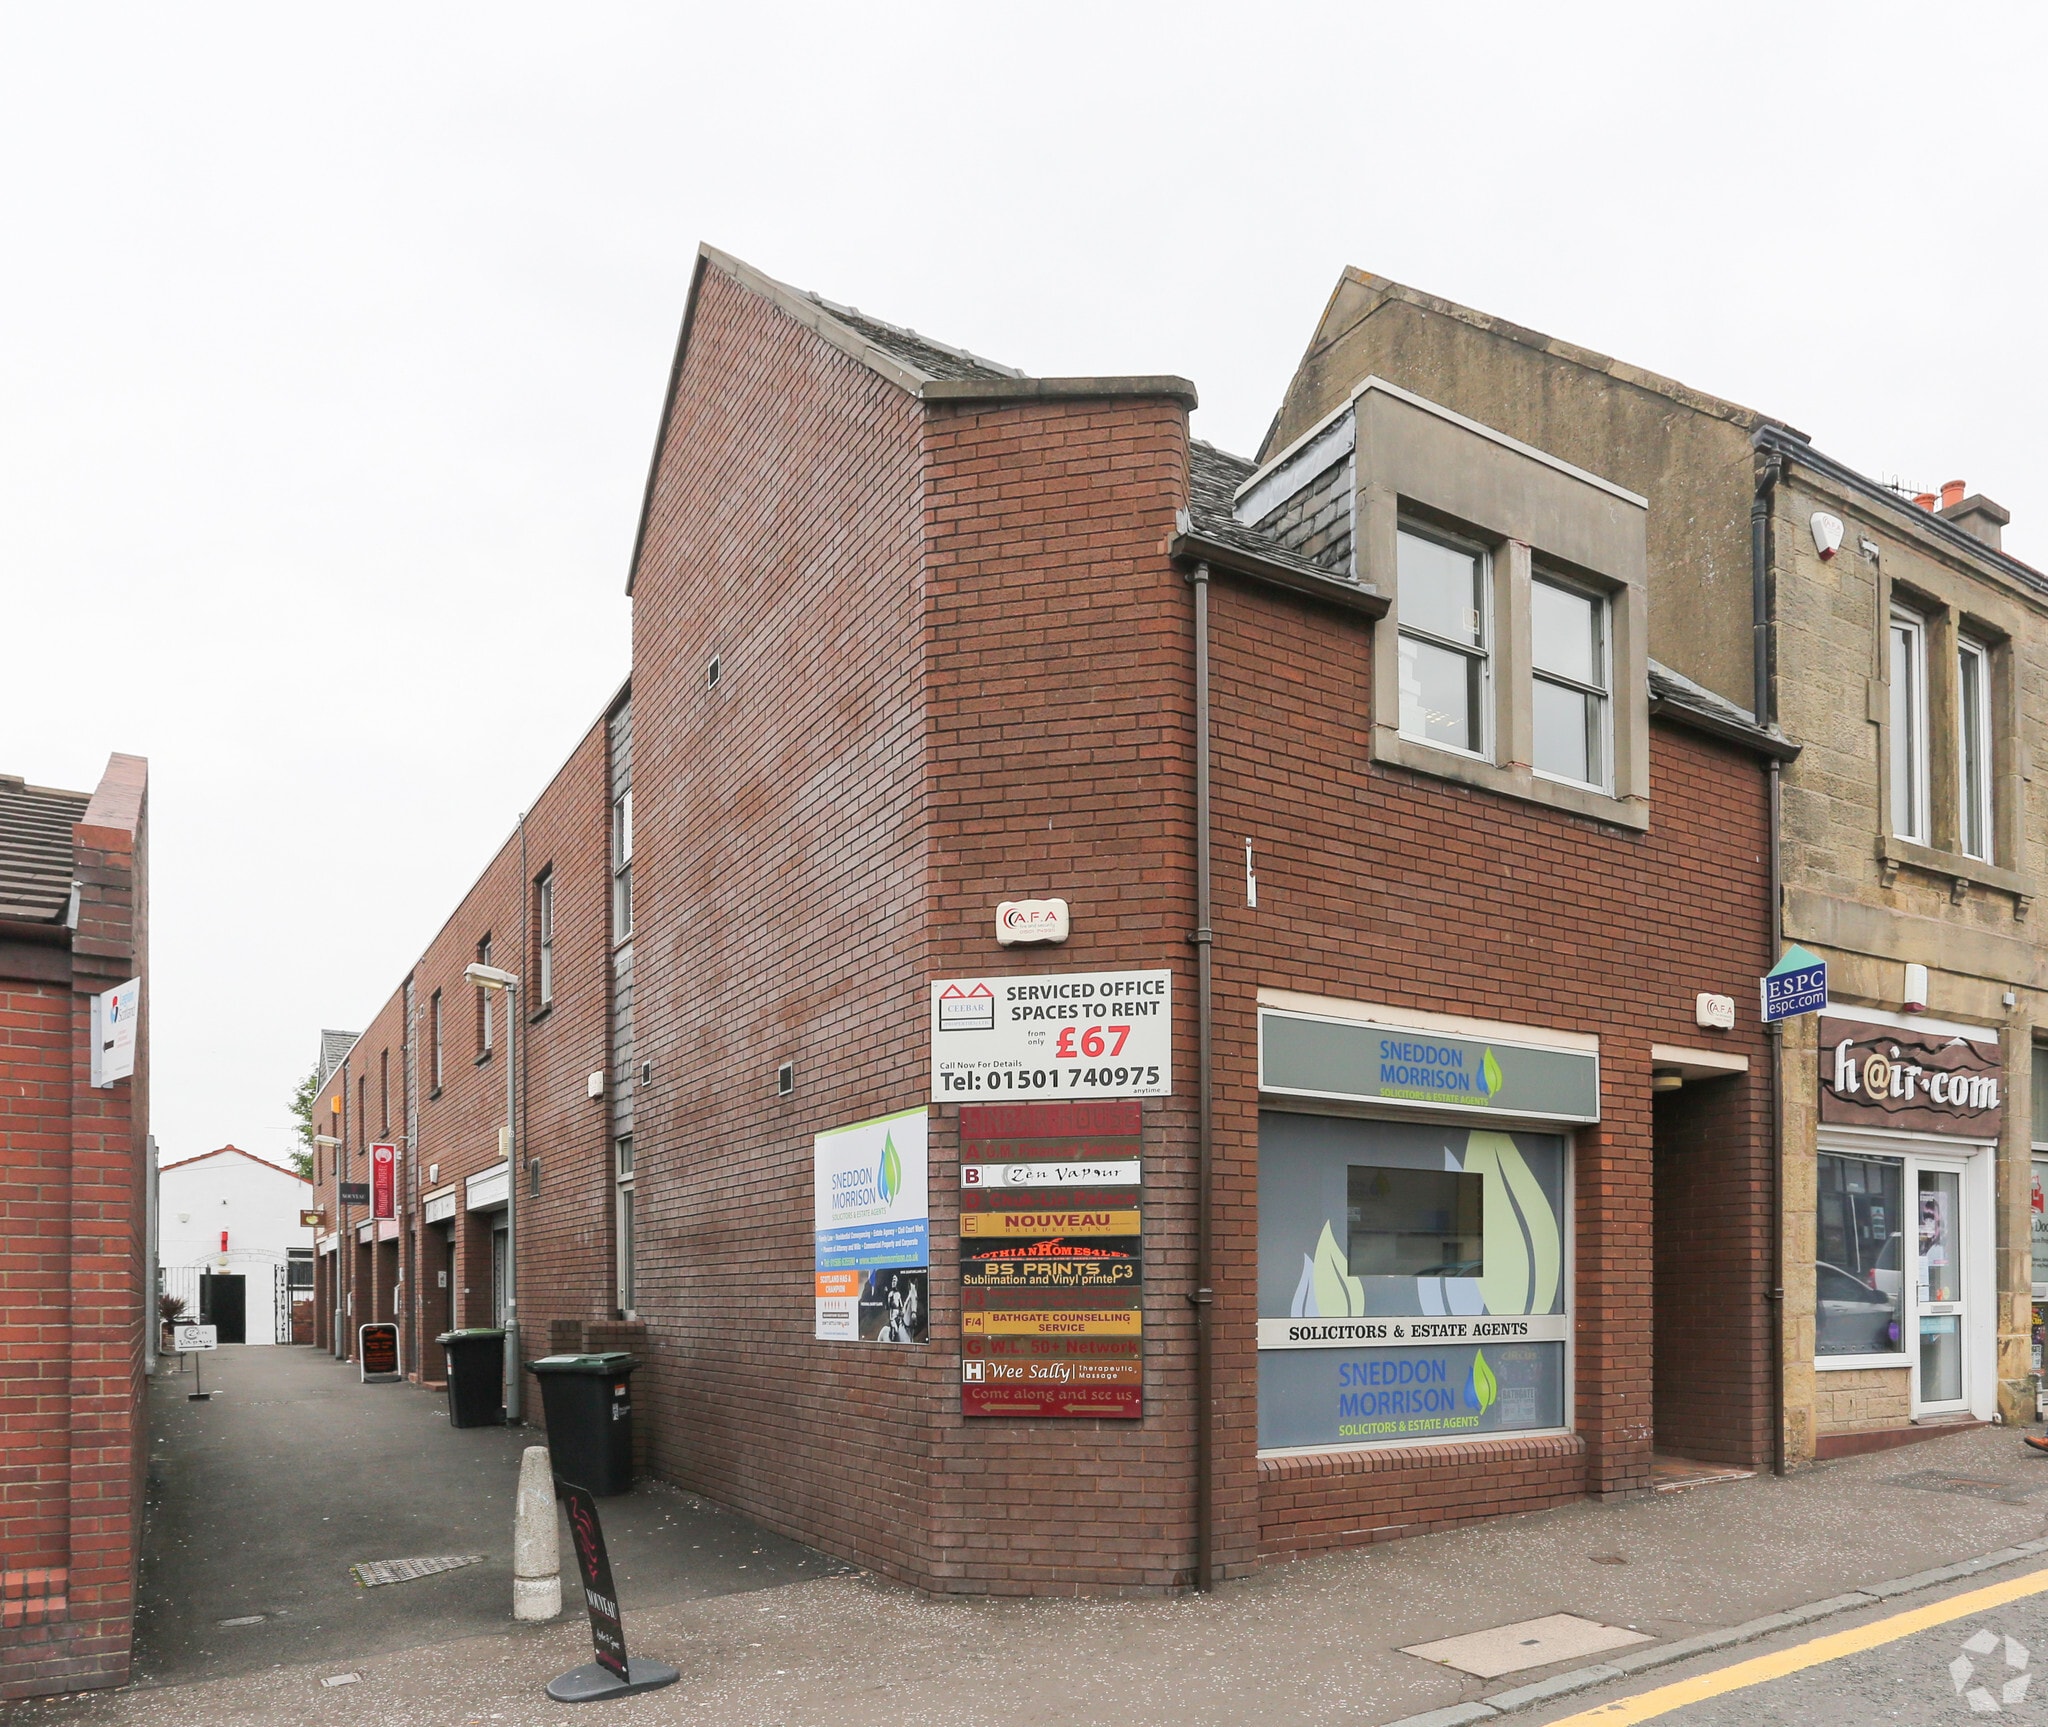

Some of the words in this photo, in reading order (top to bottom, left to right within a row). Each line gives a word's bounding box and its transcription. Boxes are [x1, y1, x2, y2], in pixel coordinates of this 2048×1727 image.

[1007, 983, 1095, 1001] SERVICED
[1100, 980, 1165, 997] OFFICE
[1769, 971, 1823, 998] ESPC
[947, 1003, 984, 1012] CEEBAR
[1011, 1004, 1078, 1021] SPACES
[1082, 1003, 1107, 1018] TO
[1112, 1001, 1160, 1017] RENT
[1769, 993, 1824, 1015] espc.com
[1028, 1038, 1045, 1046] only
[1055, 1025, 1131, 1059] £67
[1380, 1040, 1463, 1068] SNEDDON
[940, 1061, 956, 1070] Call
[993, 1060, 1023, 1068] Details
[940, 1071, 982, 1091] Tel:
[987, 1069, 1059, 1090] 01501
[1068, 1066, 1160, 1087] 740975
[1380, 1063, 1470, 1091] MORRISON
[1133, 1087, 1161, 1095] anytime
[1380, 1088, 1425, 1100] SOLICITORS
[1433, 1093, 1460, 1102] ESTATE
[1460, 1096, 1489, 1107] AGENTS
[1058, 1105, 1137, 1130] HOUSE
[965, 1145, 980, 1160] A
[1082, 1142, 1141, 1157] Services
[832, 1167, 873, 1190] SNEDDON
[965, 1168, 980, 1184] B
[1011, 1168, 1048, 1182] Zen
[1055, 1167, 1122, 1182] Vapour
[832, 1187, 876, 1210] MORRISON
[965, 1193, 980, 1209] D
[1074, 1189, 1137, 1206] Palace
[832, 1211, 853, 1221] SOLICITORS
[857, 1209, 870, 1218] ESTATE
[871, 1207, 887, 1216] AGENTS
[965, 1217, 976, 1232] E
[1005, 1214, 1111, 1227] NOUVEAU
[985, 1263, 1015, 1275] BS
[1023, 1262, 1100, 1276] PRINTS
[1111, 1264, 1133, 1278] C3
[963, 1274, 1027, 1285] Sublimation
[1029, 1274, 1049, 1285] and
[1051, 1274, 1079, 1286] Vinyl
[1082, 1274, 1117, 1286] printer
[964, 1290, 985, 1306] F3
[965, 1318, 982, 1327] F/4
[1038, 1323, 1085, 1332] SERVICE
[992, 1313, 1049, 1322] BATHGATE
[1052, 1313, 1131, 1322] COUNSELLING
[1289, 1325, 1387, 1341] SOLICITORS
[1393, 1325, 1405, 1338] &
[1410, 1323, 1467, 1338] ESTATE
[1472, 1322, 1528, 1337] AGENTS
[967, 1339, 982, 1355] G
[991, 1340, 1025, 1354] W.L.
[1031, 1340, 1060, 1354] 50+
[1066, 1340, 1138, 1354] Network
[966, 1363, 982, 1380] H
[988, 1362, 1023, 1379] Wee
[1029, 1363, 1071, 1383] Sally
[1079, 1365, 1133, 1373] Therapeutic
[1339, 1360, 1446, 1388] SNEDDON
[971, 1388, 1009, 1400] Come
[1013, 1388, 1055, 1403] along
[1058, 1388, 1087, 1400] and
[1091, 1391, 1112, 1400] see
[1116, 1391, 1132, 1400] us
[1340, 1388, 1455, 1417] MORRISON
[1338, 1421, 1397, 1436] SOLICITORS
[1399, 1421, 1407, 1432] &
[1408, 1418, 1441, 1432] ESTATE
[1443, 1416, 1479, 1429] AGENTS
[586, 1588, 617, 1620] NOUVEAU
